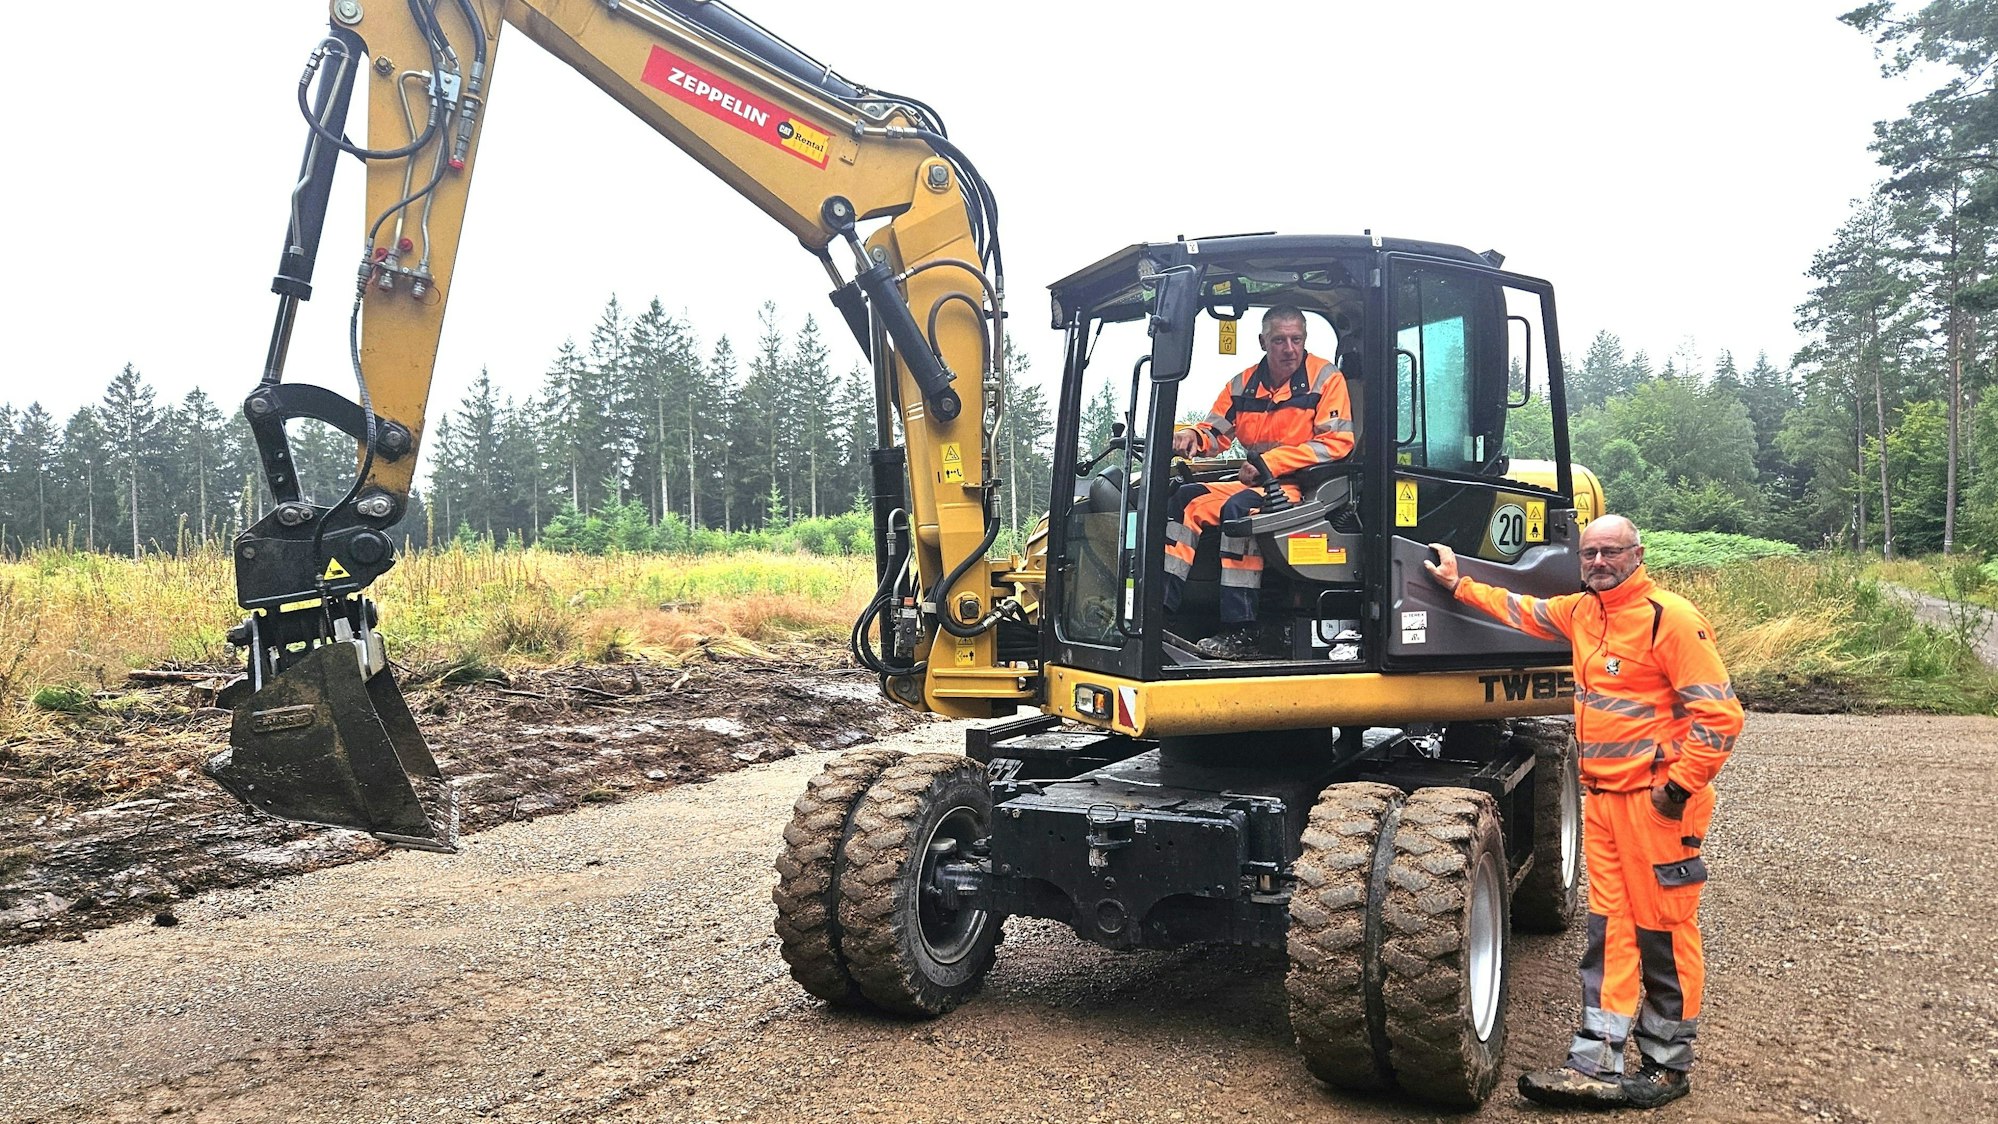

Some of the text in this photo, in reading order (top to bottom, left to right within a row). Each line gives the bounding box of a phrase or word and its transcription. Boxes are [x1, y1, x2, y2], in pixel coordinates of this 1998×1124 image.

[667, 67, 768, 127] ZEPPELIN
[778, 124, 824, 152] CAT Rental
[1498, 513, 1523, 546] 20
